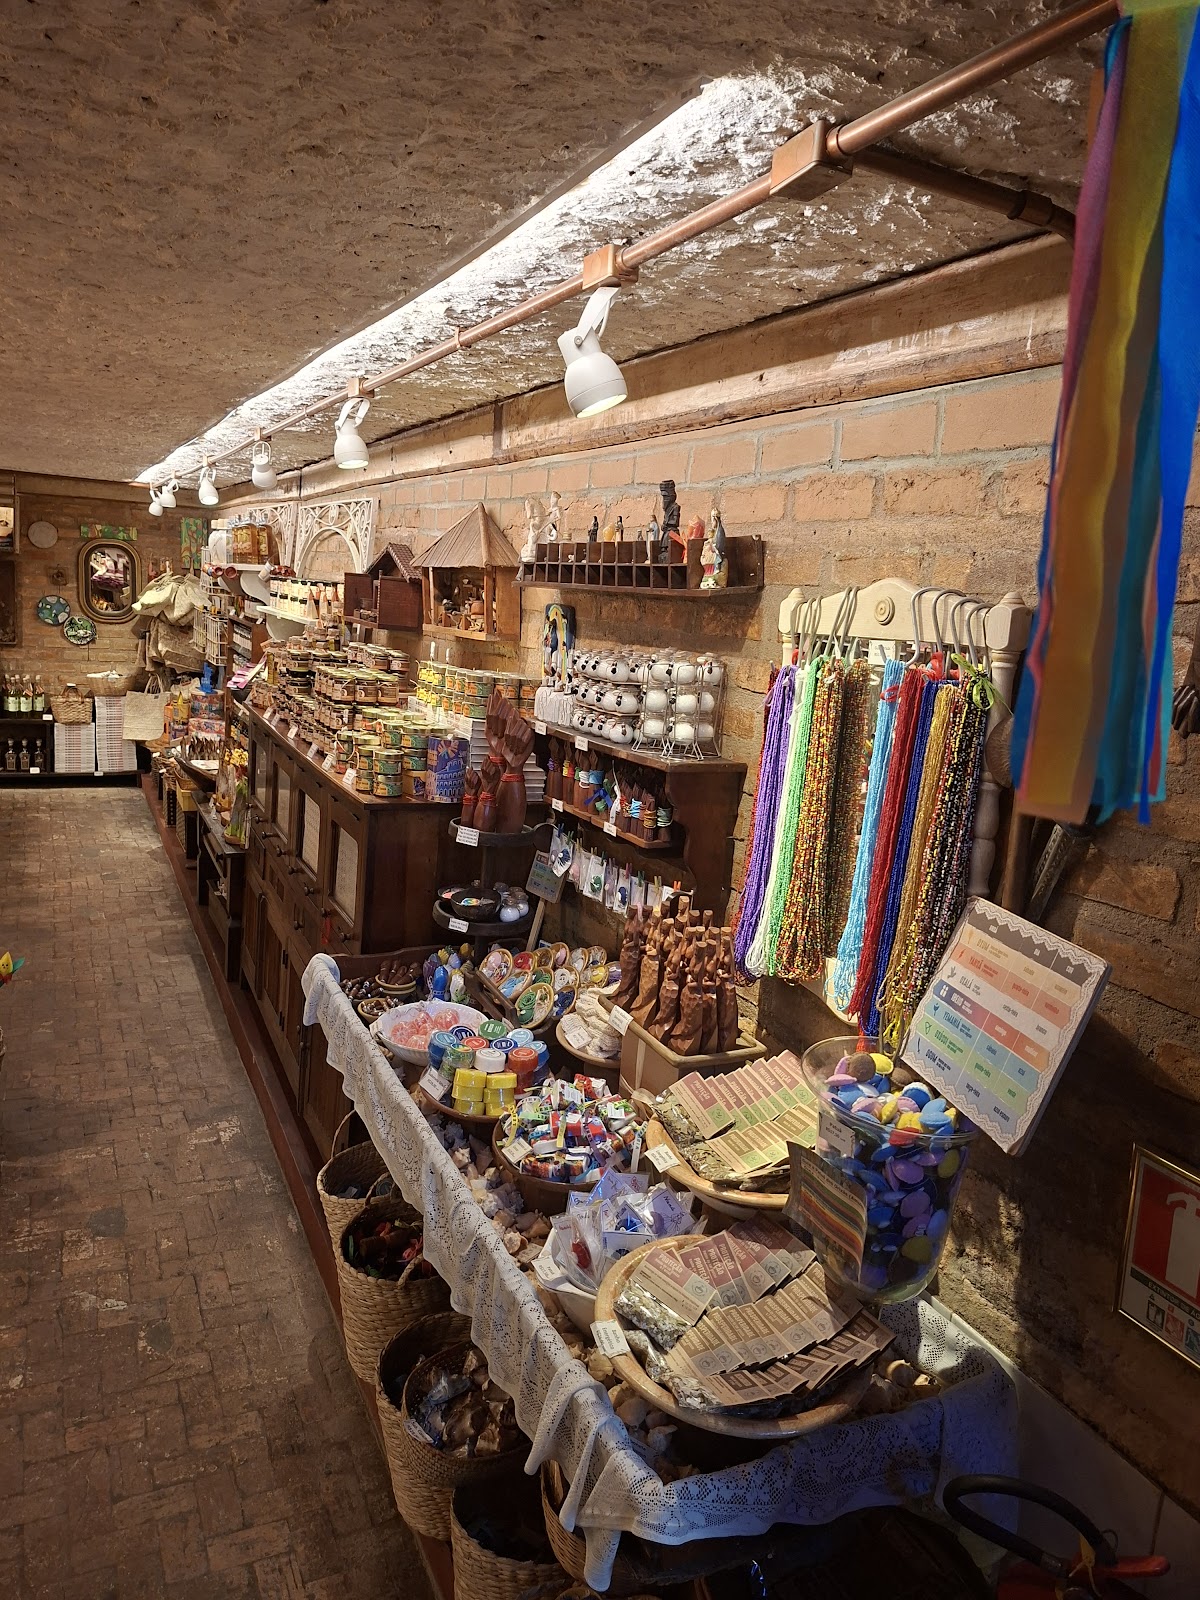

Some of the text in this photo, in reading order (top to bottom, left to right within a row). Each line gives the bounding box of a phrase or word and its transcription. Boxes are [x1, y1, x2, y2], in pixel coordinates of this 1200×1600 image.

[757, 1066, 777, 1086] PROTEÇÃO
[772, 1064, 792, 1083] PROTEÇÃO
[692, 1079, 710, 1100] PROTEÇÃO
[738, 1230, 761, 1252] PROTEÇÃO
[658, 1253, 683, 1273] PROTEÇÃO
[707, 1248, 725, 1275] PROTEÇÃO
[717, 1242, 735, 1270] PROTEÇÃO
[790, 1284, 818, 1313] PROSPERIDADE
[1148, 1281, 1179, 1306] EXTINTOR
[728, 1308, 756, 1338] PROSPERIDADE
[744, 1306, 770, 1335] PROSPERIDADE
[765, 1297, 794, 1324] PROSPERIDADE
[611, 1328, 620, 1343] Banho
[710, 1311, 738, 1342] PROSPERIDADE
